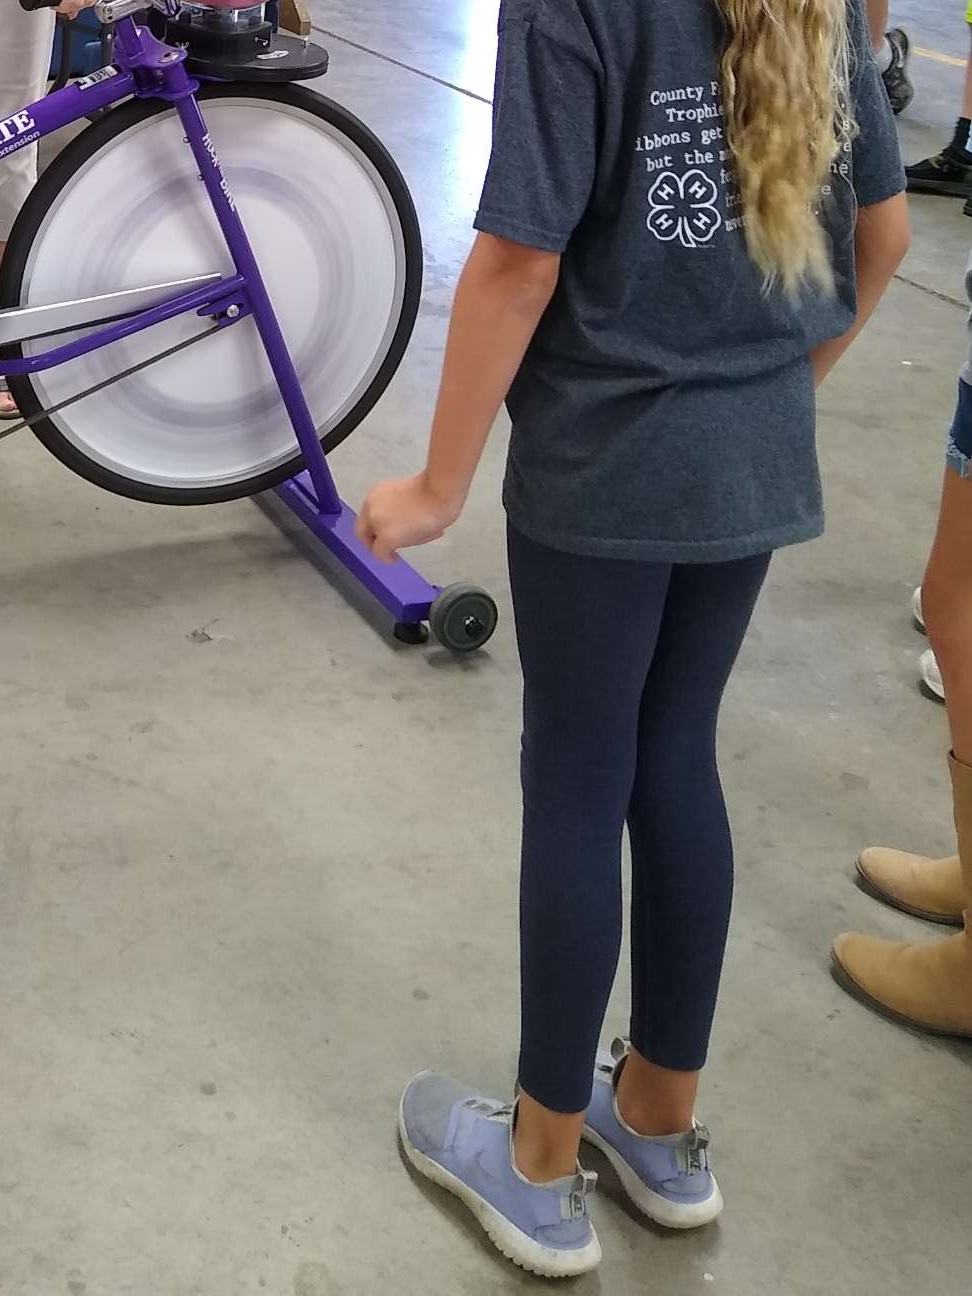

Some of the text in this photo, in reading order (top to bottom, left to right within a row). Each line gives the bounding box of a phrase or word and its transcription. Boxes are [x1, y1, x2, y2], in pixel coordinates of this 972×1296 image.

[650, 86, 704, 106] County
[665, 103, 725, 124] Trophie
[635, 126, 724, 152] ibbons get
[645, 155, 674, 173] but
[683, 149, 715, 165] the
